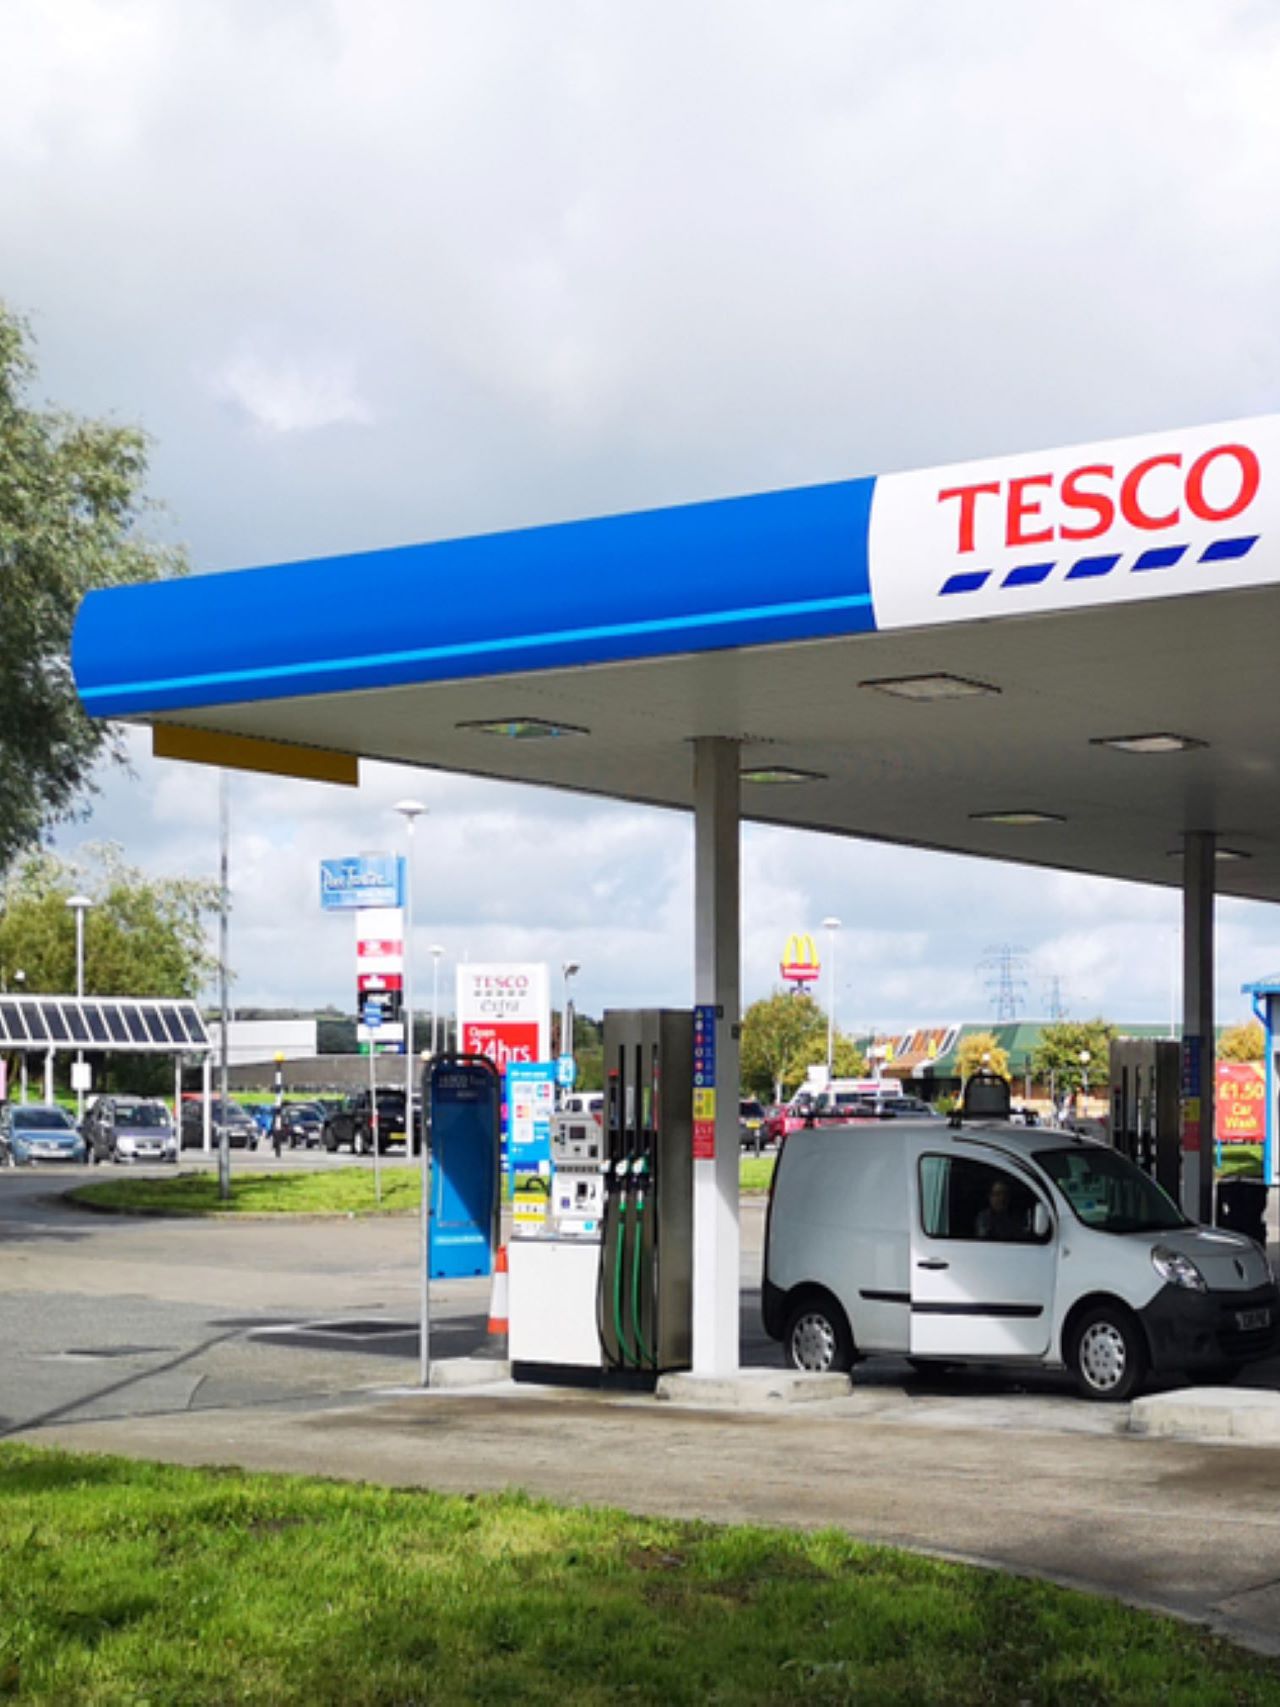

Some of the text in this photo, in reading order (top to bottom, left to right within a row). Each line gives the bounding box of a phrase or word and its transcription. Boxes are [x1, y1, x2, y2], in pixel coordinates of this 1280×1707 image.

[938, 444, 1260, 553] TESCO
[473, 975, 528, 988] TESCO
[1219, 1081, 1264, 1100] £1.50
[1232, 1102, 1252, 1115] Car
[1226, 1116, 1256, 1129] Wash
